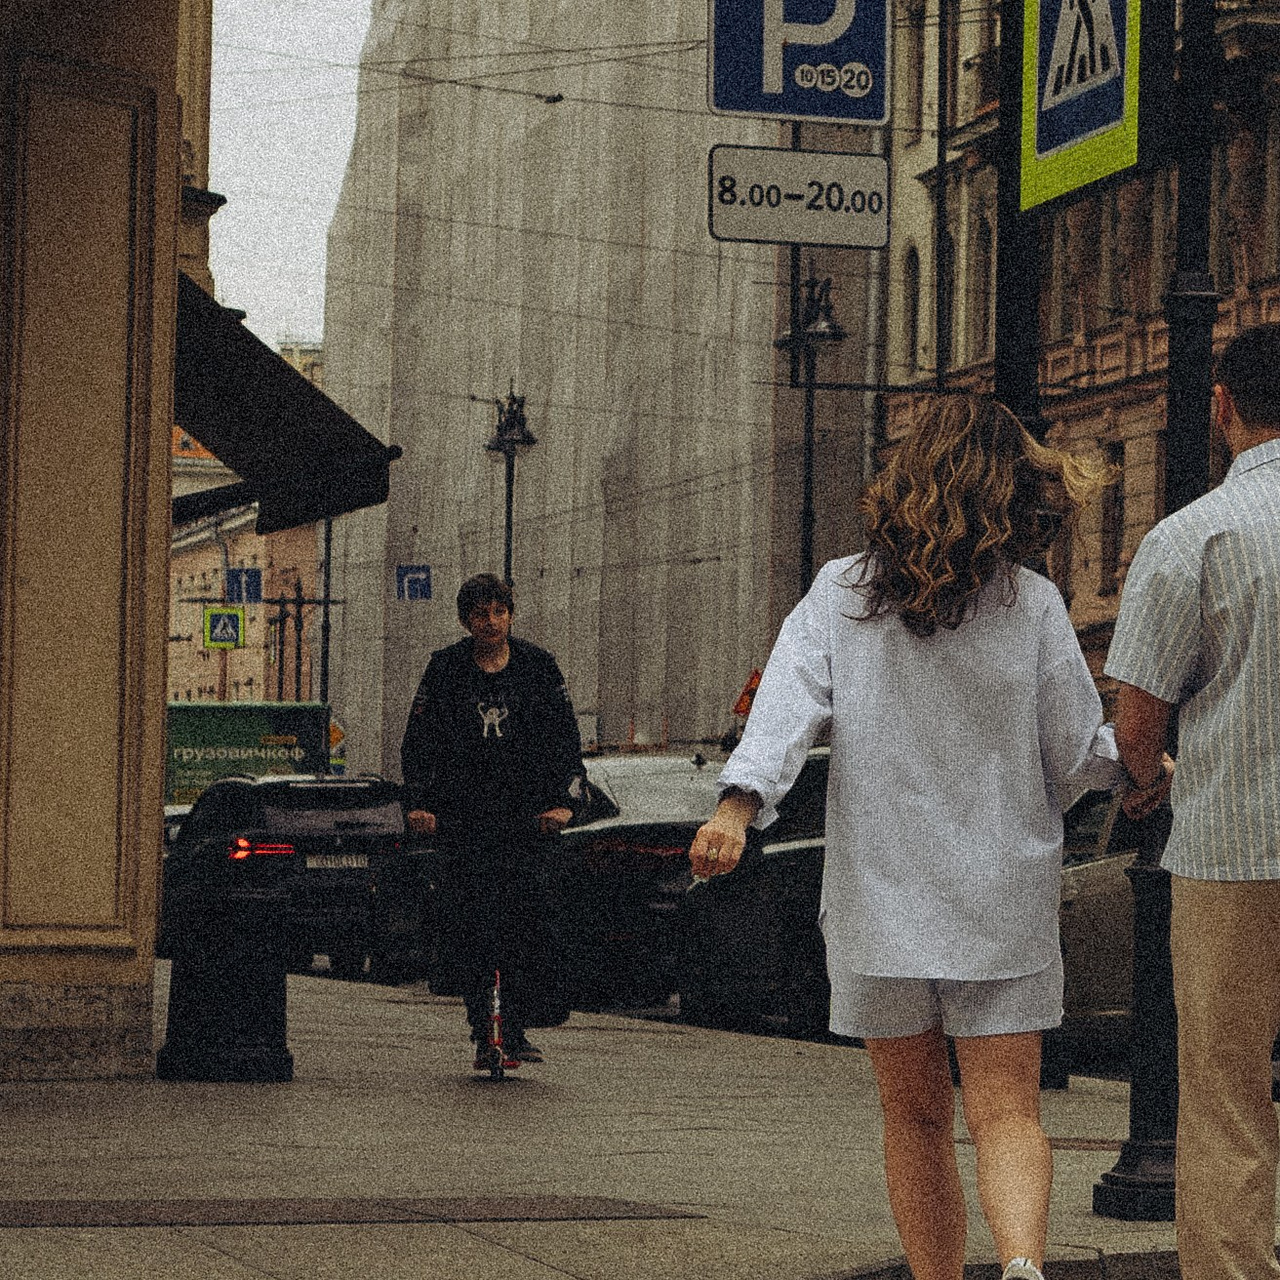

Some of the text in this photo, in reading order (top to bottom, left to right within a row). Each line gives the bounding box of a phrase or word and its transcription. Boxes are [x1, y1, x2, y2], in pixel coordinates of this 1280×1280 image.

[799, 67, 870, 92] 10 15 20
